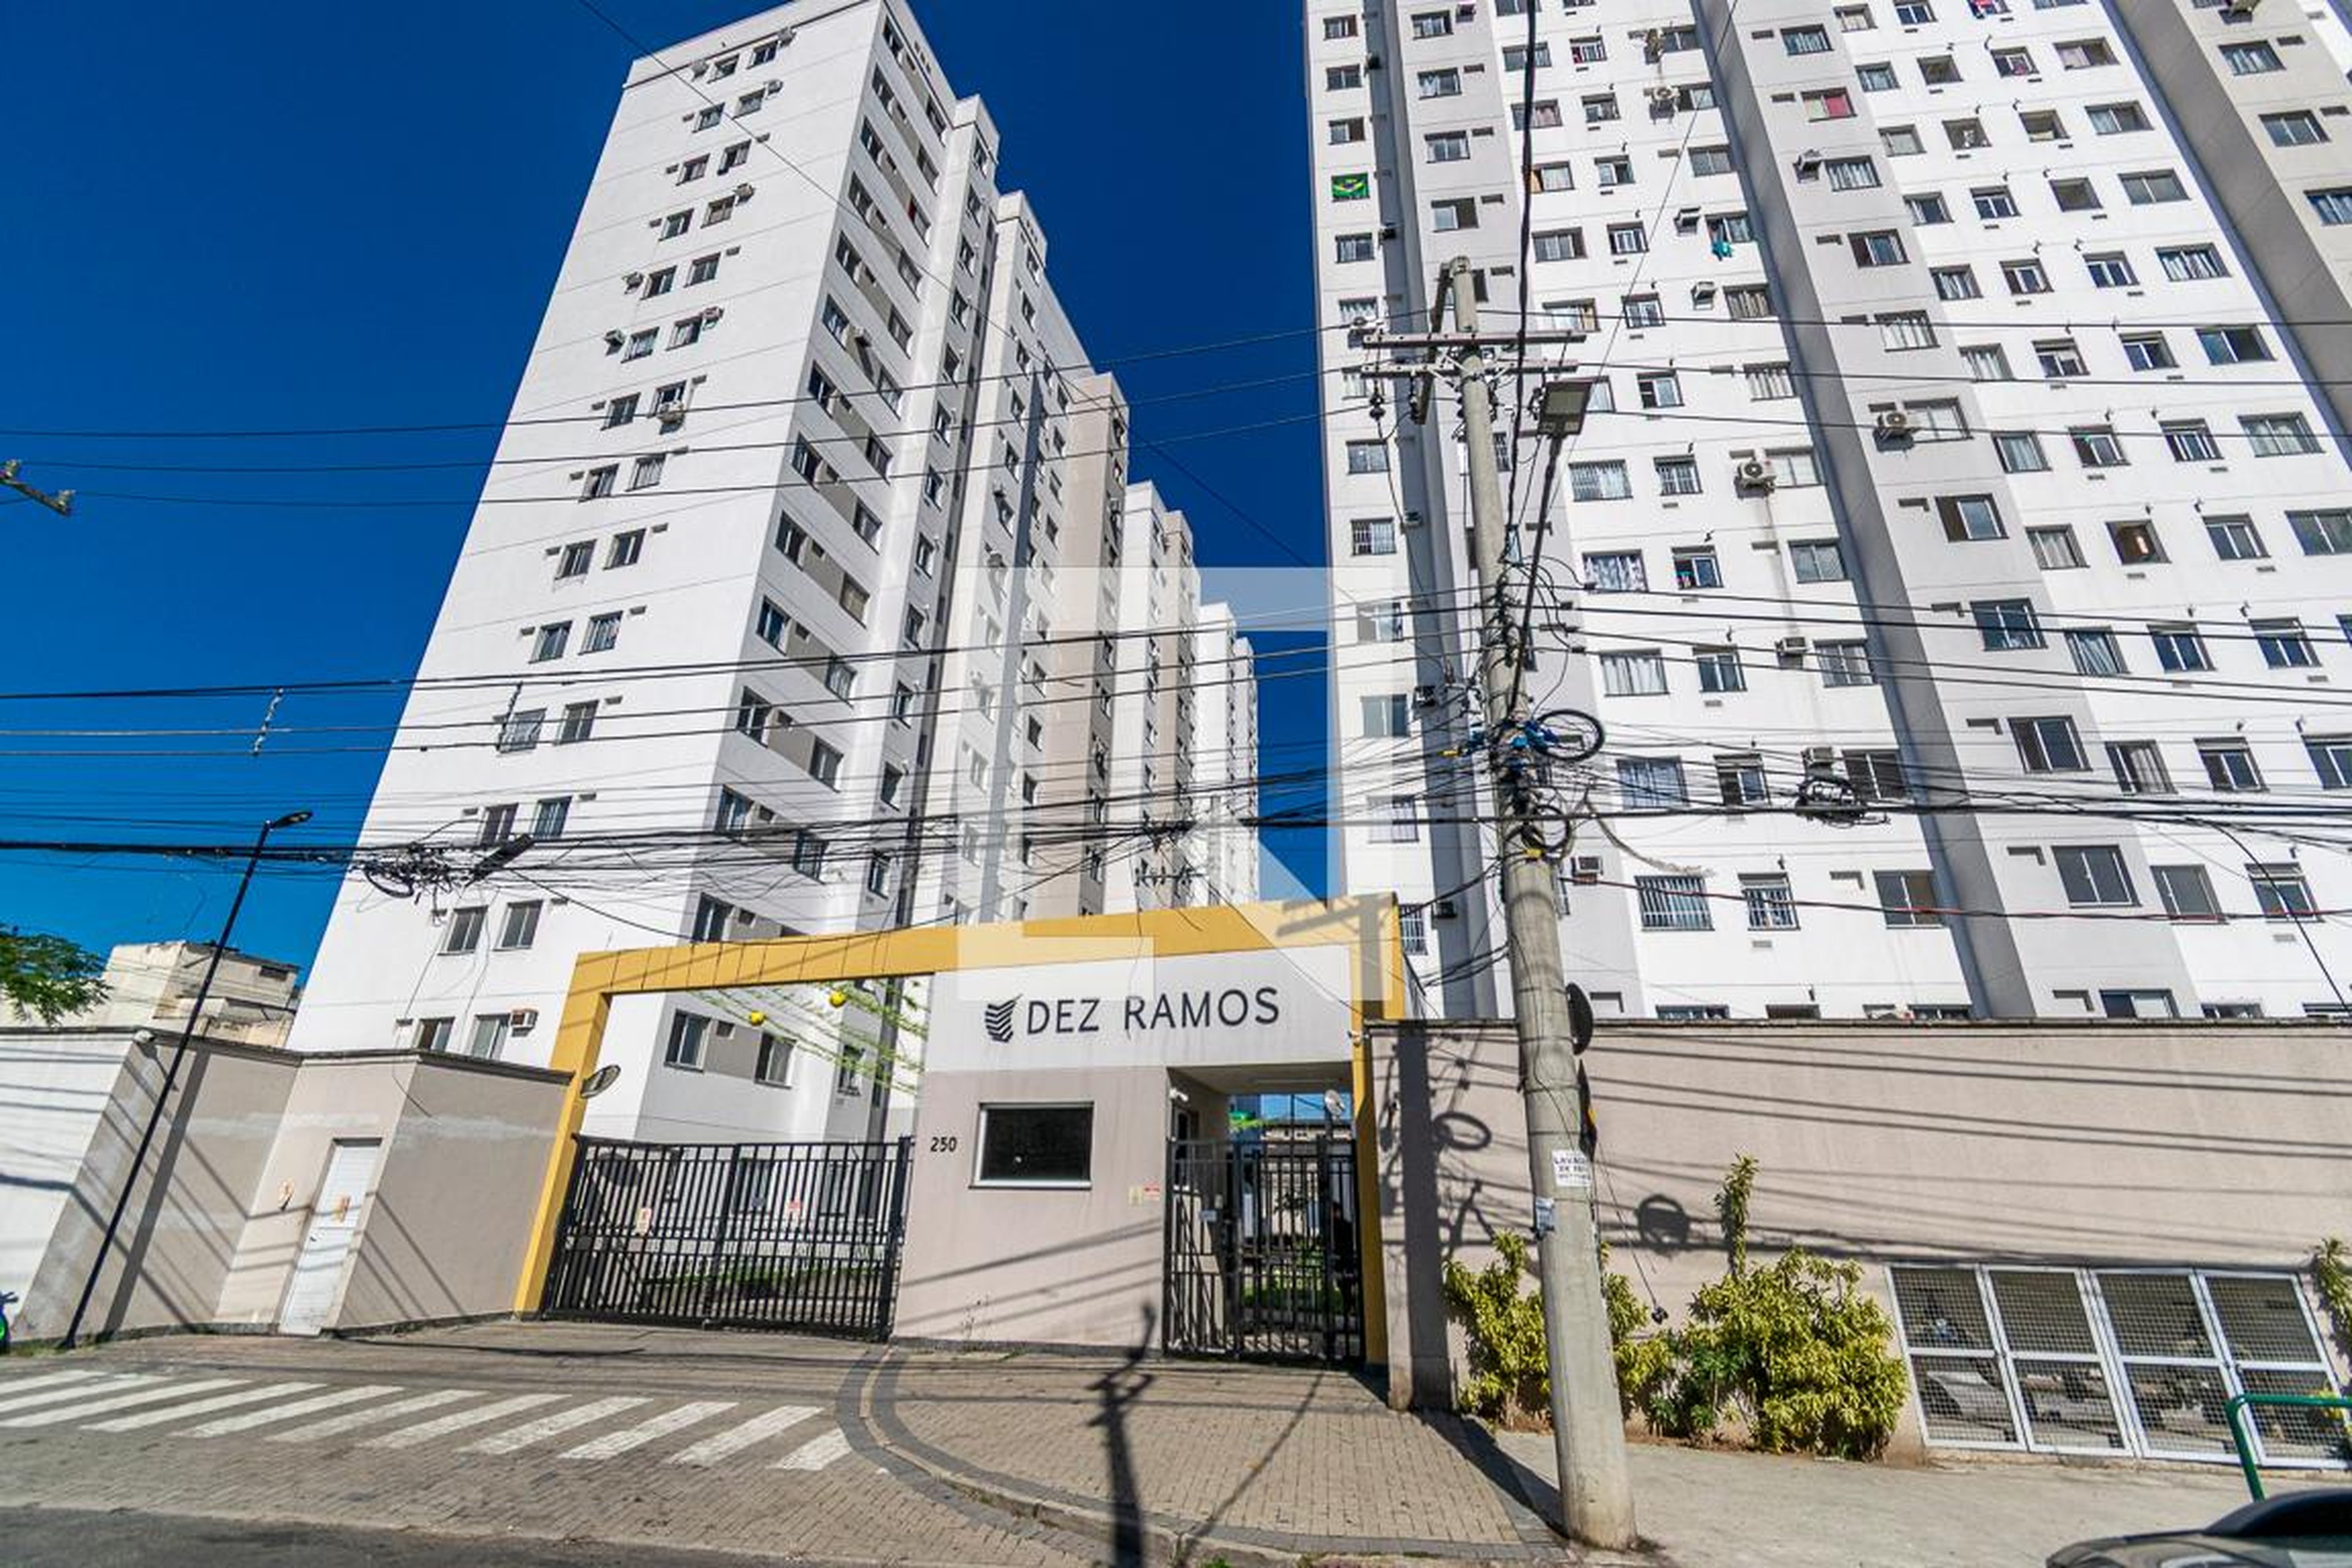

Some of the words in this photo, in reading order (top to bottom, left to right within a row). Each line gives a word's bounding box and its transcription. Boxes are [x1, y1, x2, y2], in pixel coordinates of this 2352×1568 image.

[1028, 999, 1101, 1034] DEZ
[1125, 987, 1280, 1030] RAMOS
[930, 1136, 958, 1153] 250
